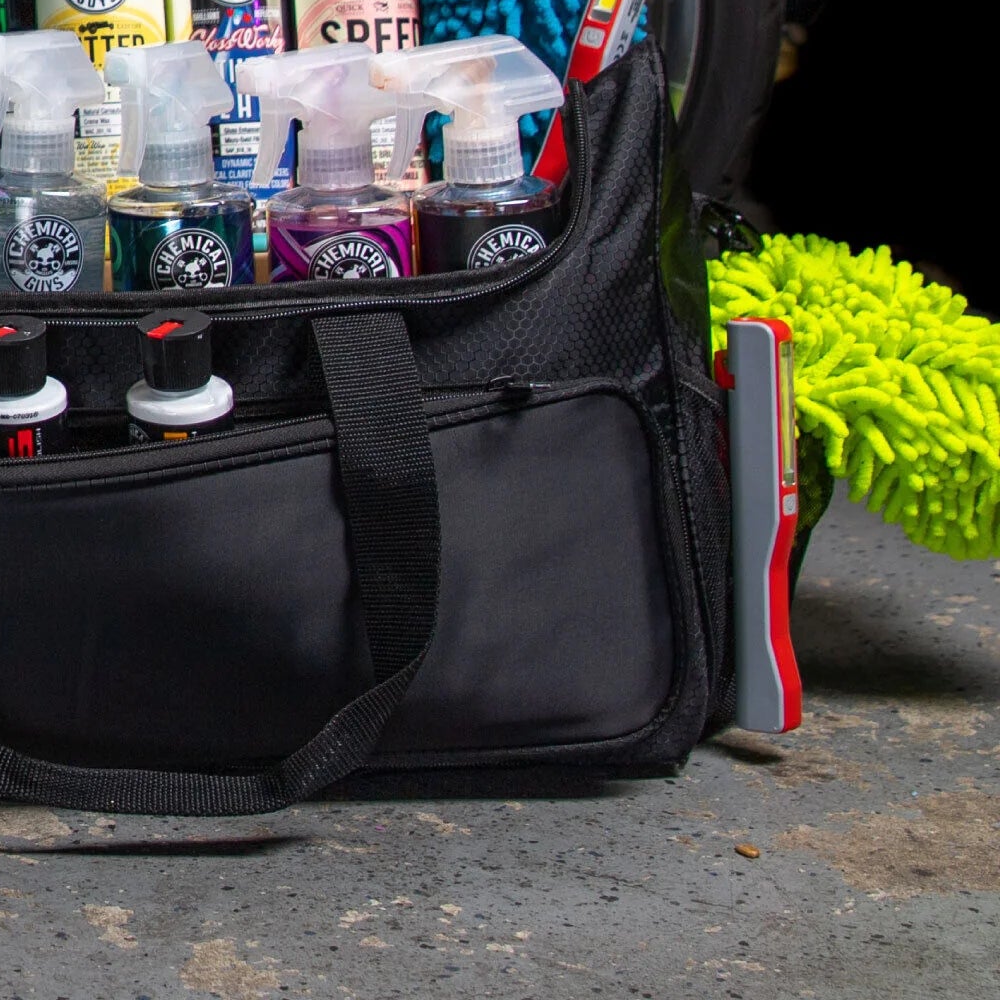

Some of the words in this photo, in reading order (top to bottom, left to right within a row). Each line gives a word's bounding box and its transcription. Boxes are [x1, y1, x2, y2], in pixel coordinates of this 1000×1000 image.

[9, 221, 79, 258] CHEMICAL
[157, 235, 226, 275] CHEMICAL
[474, 232, 540, 269] CHEMICA
[314, 242, 385, 279] CHEMICAL
